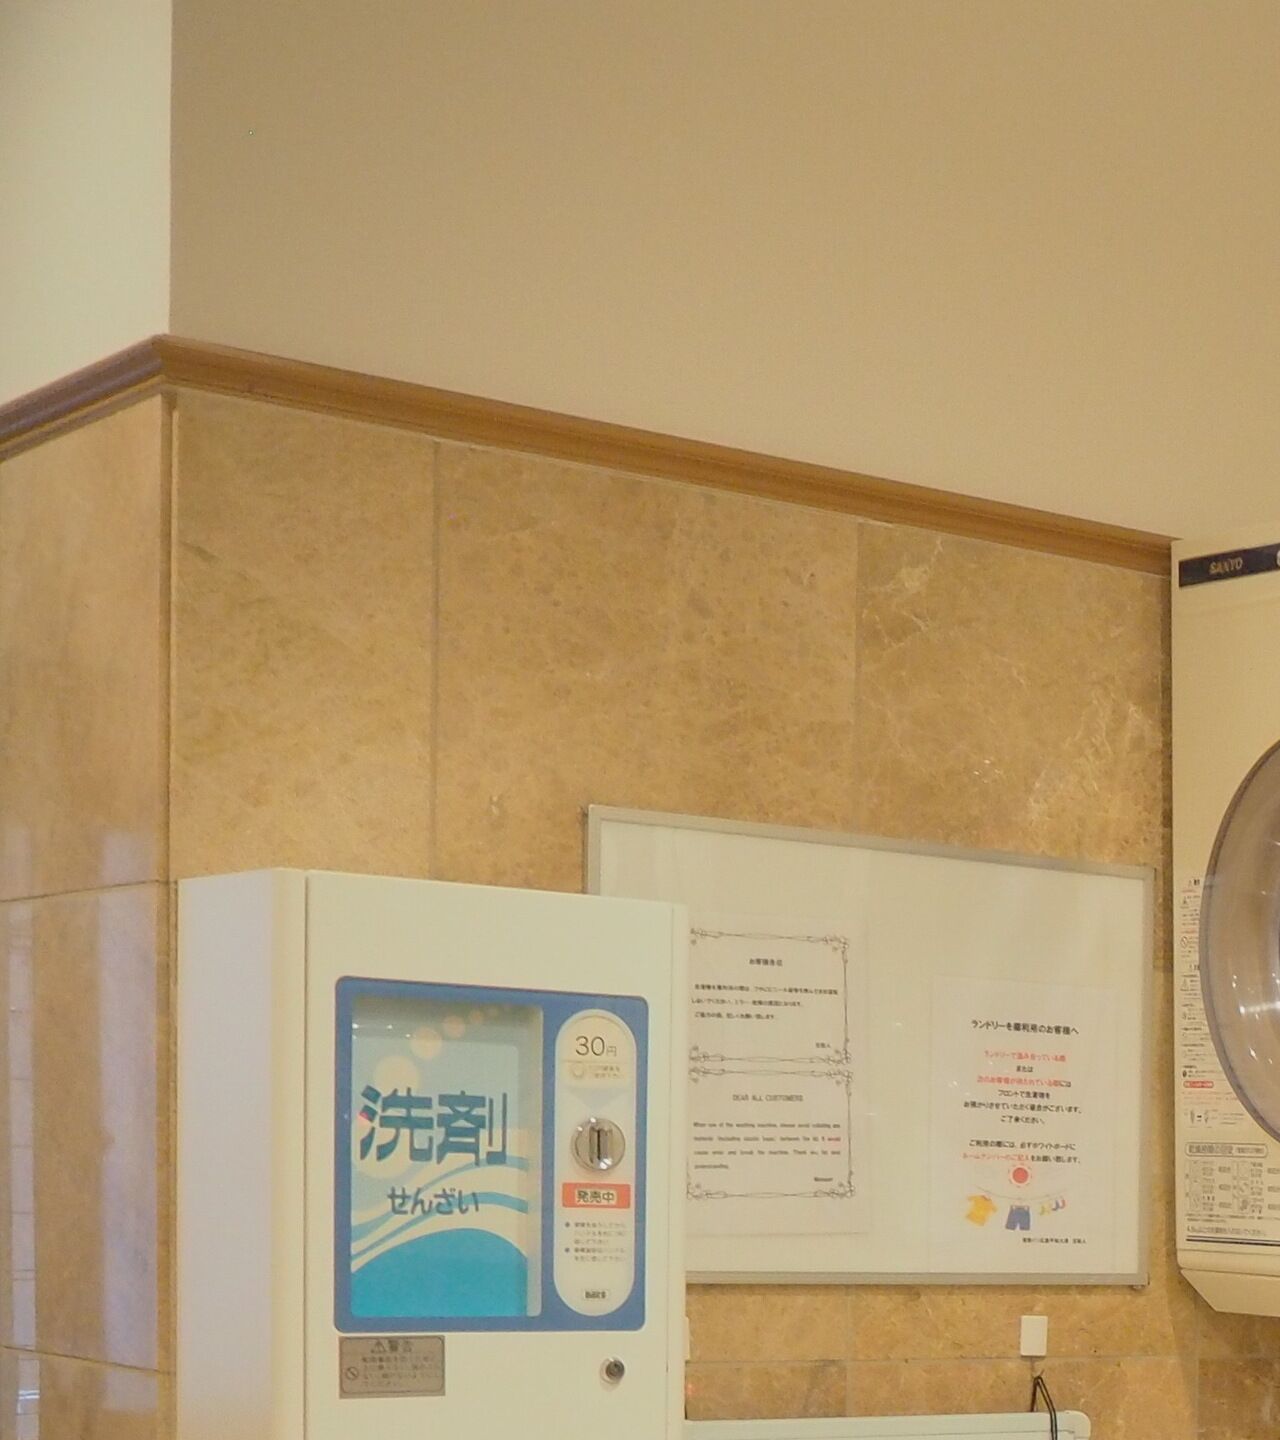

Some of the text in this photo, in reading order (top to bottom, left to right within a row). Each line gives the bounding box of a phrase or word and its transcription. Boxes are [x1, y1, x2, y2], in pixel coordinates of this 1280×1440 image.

[1210, 558, 1243, 575] SANYO
[575, 1036, 618, 1058] 30円
[360, 1085, 507, 1166] 洗剤
[387, 1186, 479, 1216] せんざい
[576, 1188, 615, 1204] 発売中
